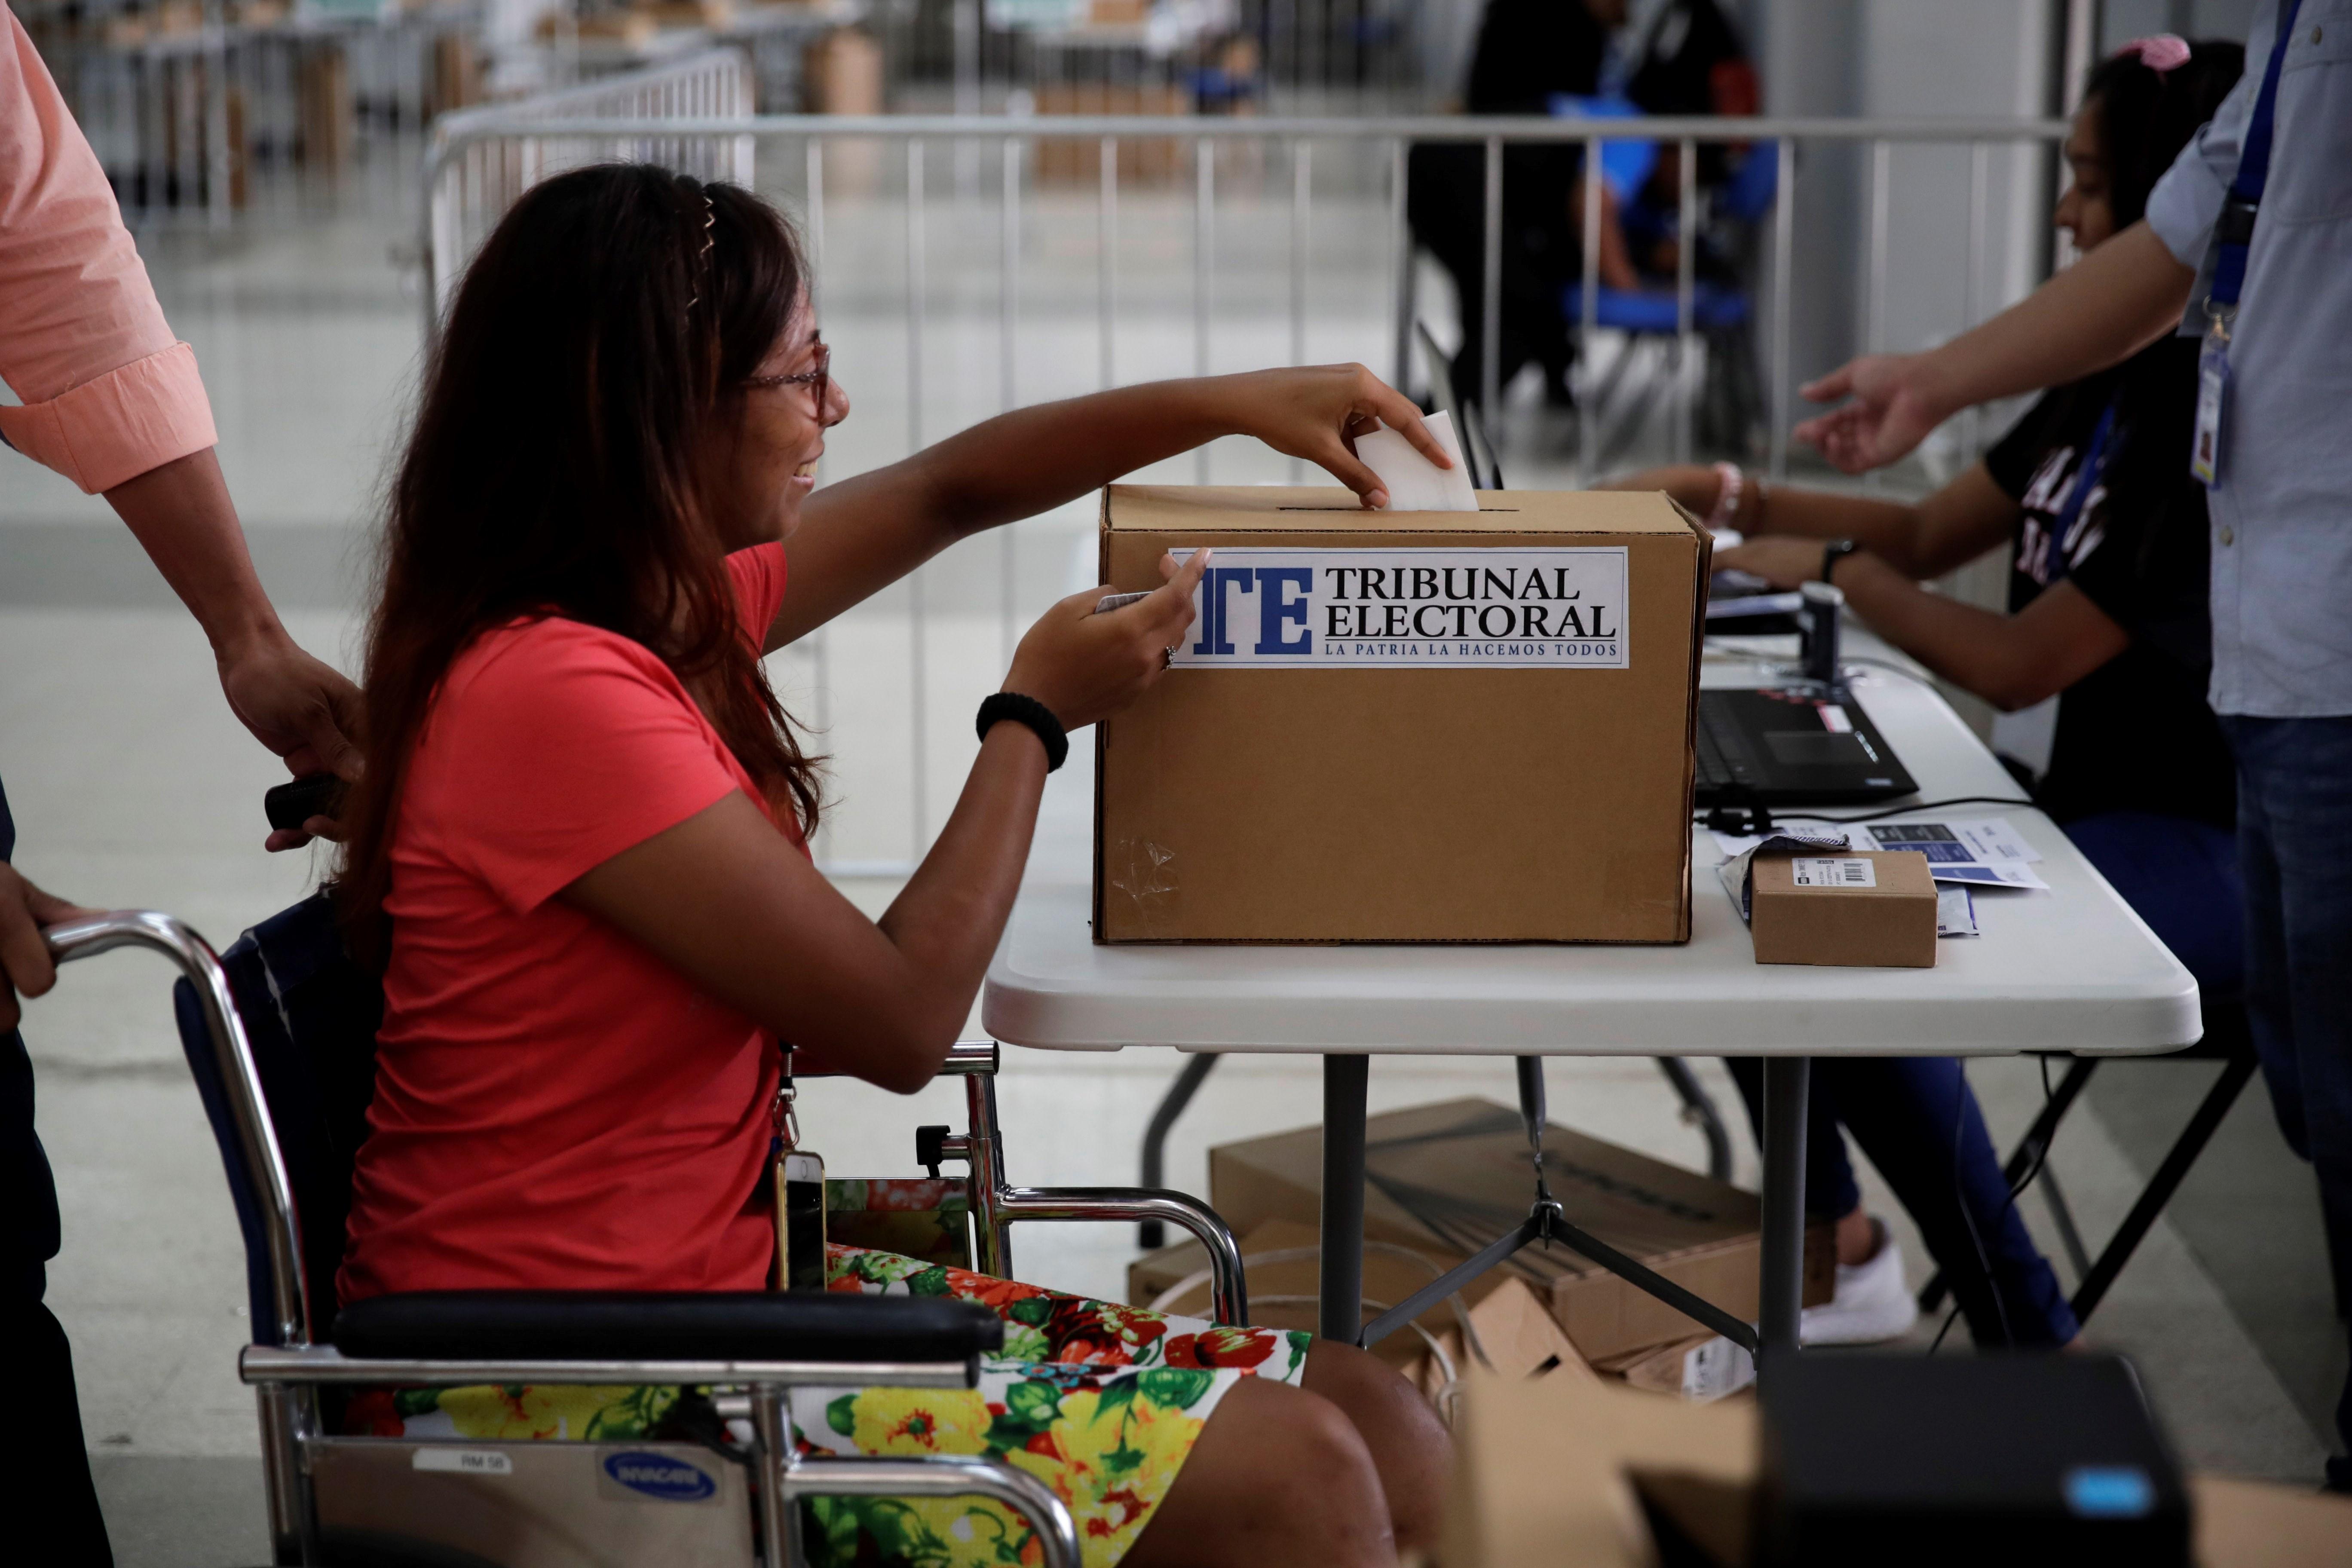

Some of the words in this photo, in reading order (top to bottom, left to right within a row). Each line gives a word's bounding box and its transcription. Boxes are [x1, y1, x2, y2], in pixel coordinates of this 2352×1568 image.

[1325, 568, 1580, 600] TRIBUNAL
[1194, 567, 1313, 655] TE
[1325, 605, 1616, 638] ELECTORAL
[1325, 643, 1345, 655] LA
[1356, 643, 1419, 655] PATRIA
[1429, 644, 1449, 655] LA
[1459, 643, 1545, 656] HACEMOS
[1555, 644, 1617, 656] TODOS
